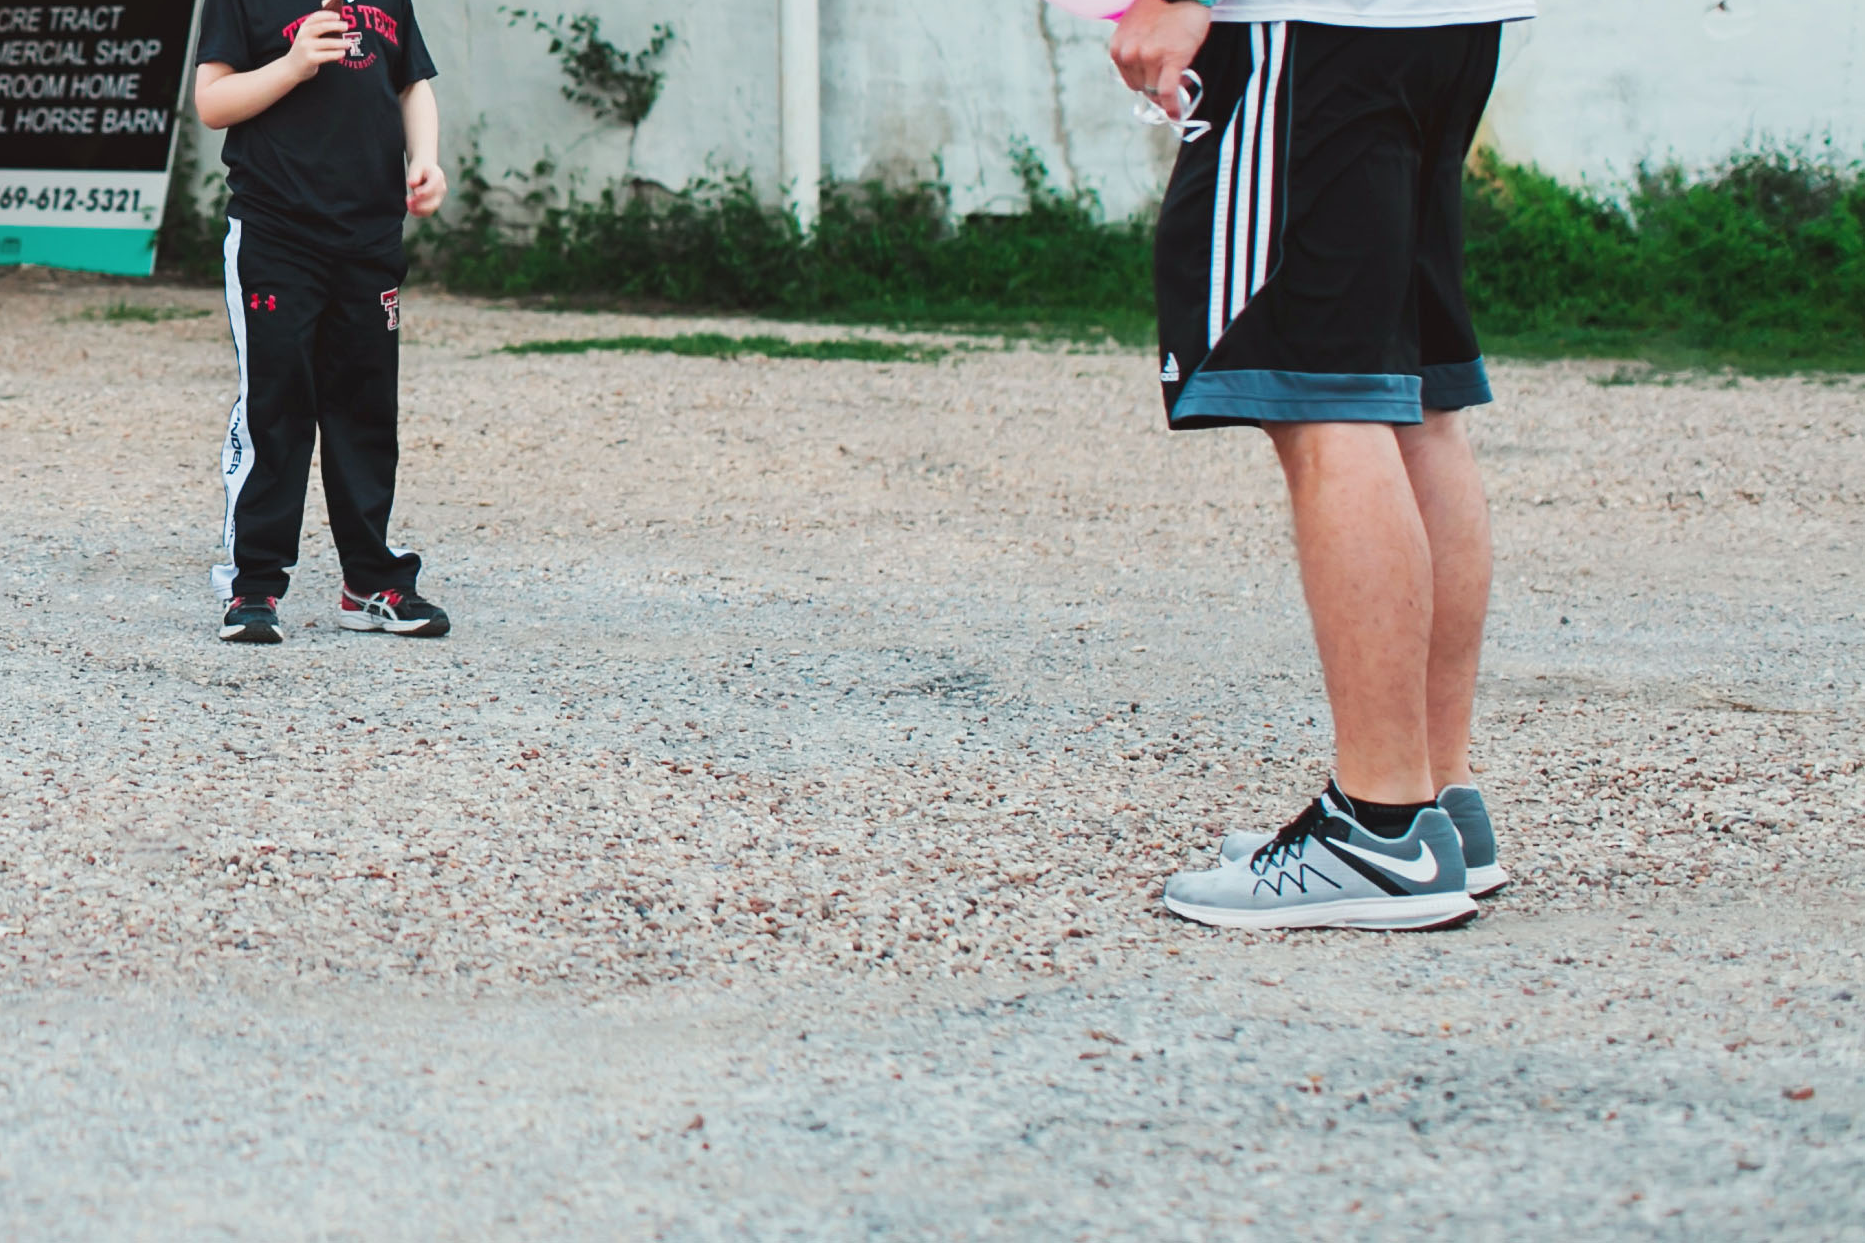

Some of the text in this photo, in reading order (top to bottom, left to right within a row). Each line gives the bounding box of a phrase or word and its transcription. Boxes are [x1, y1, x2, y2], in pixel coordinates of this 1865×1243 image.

[49, 5, 124, 32] TRACT
[94, 39, 162, 66] SHOP
[70, 73, 141, 100] HOME
[14, 107, 98, 134] HORSE
[101, 107, 168, 135] BARN
